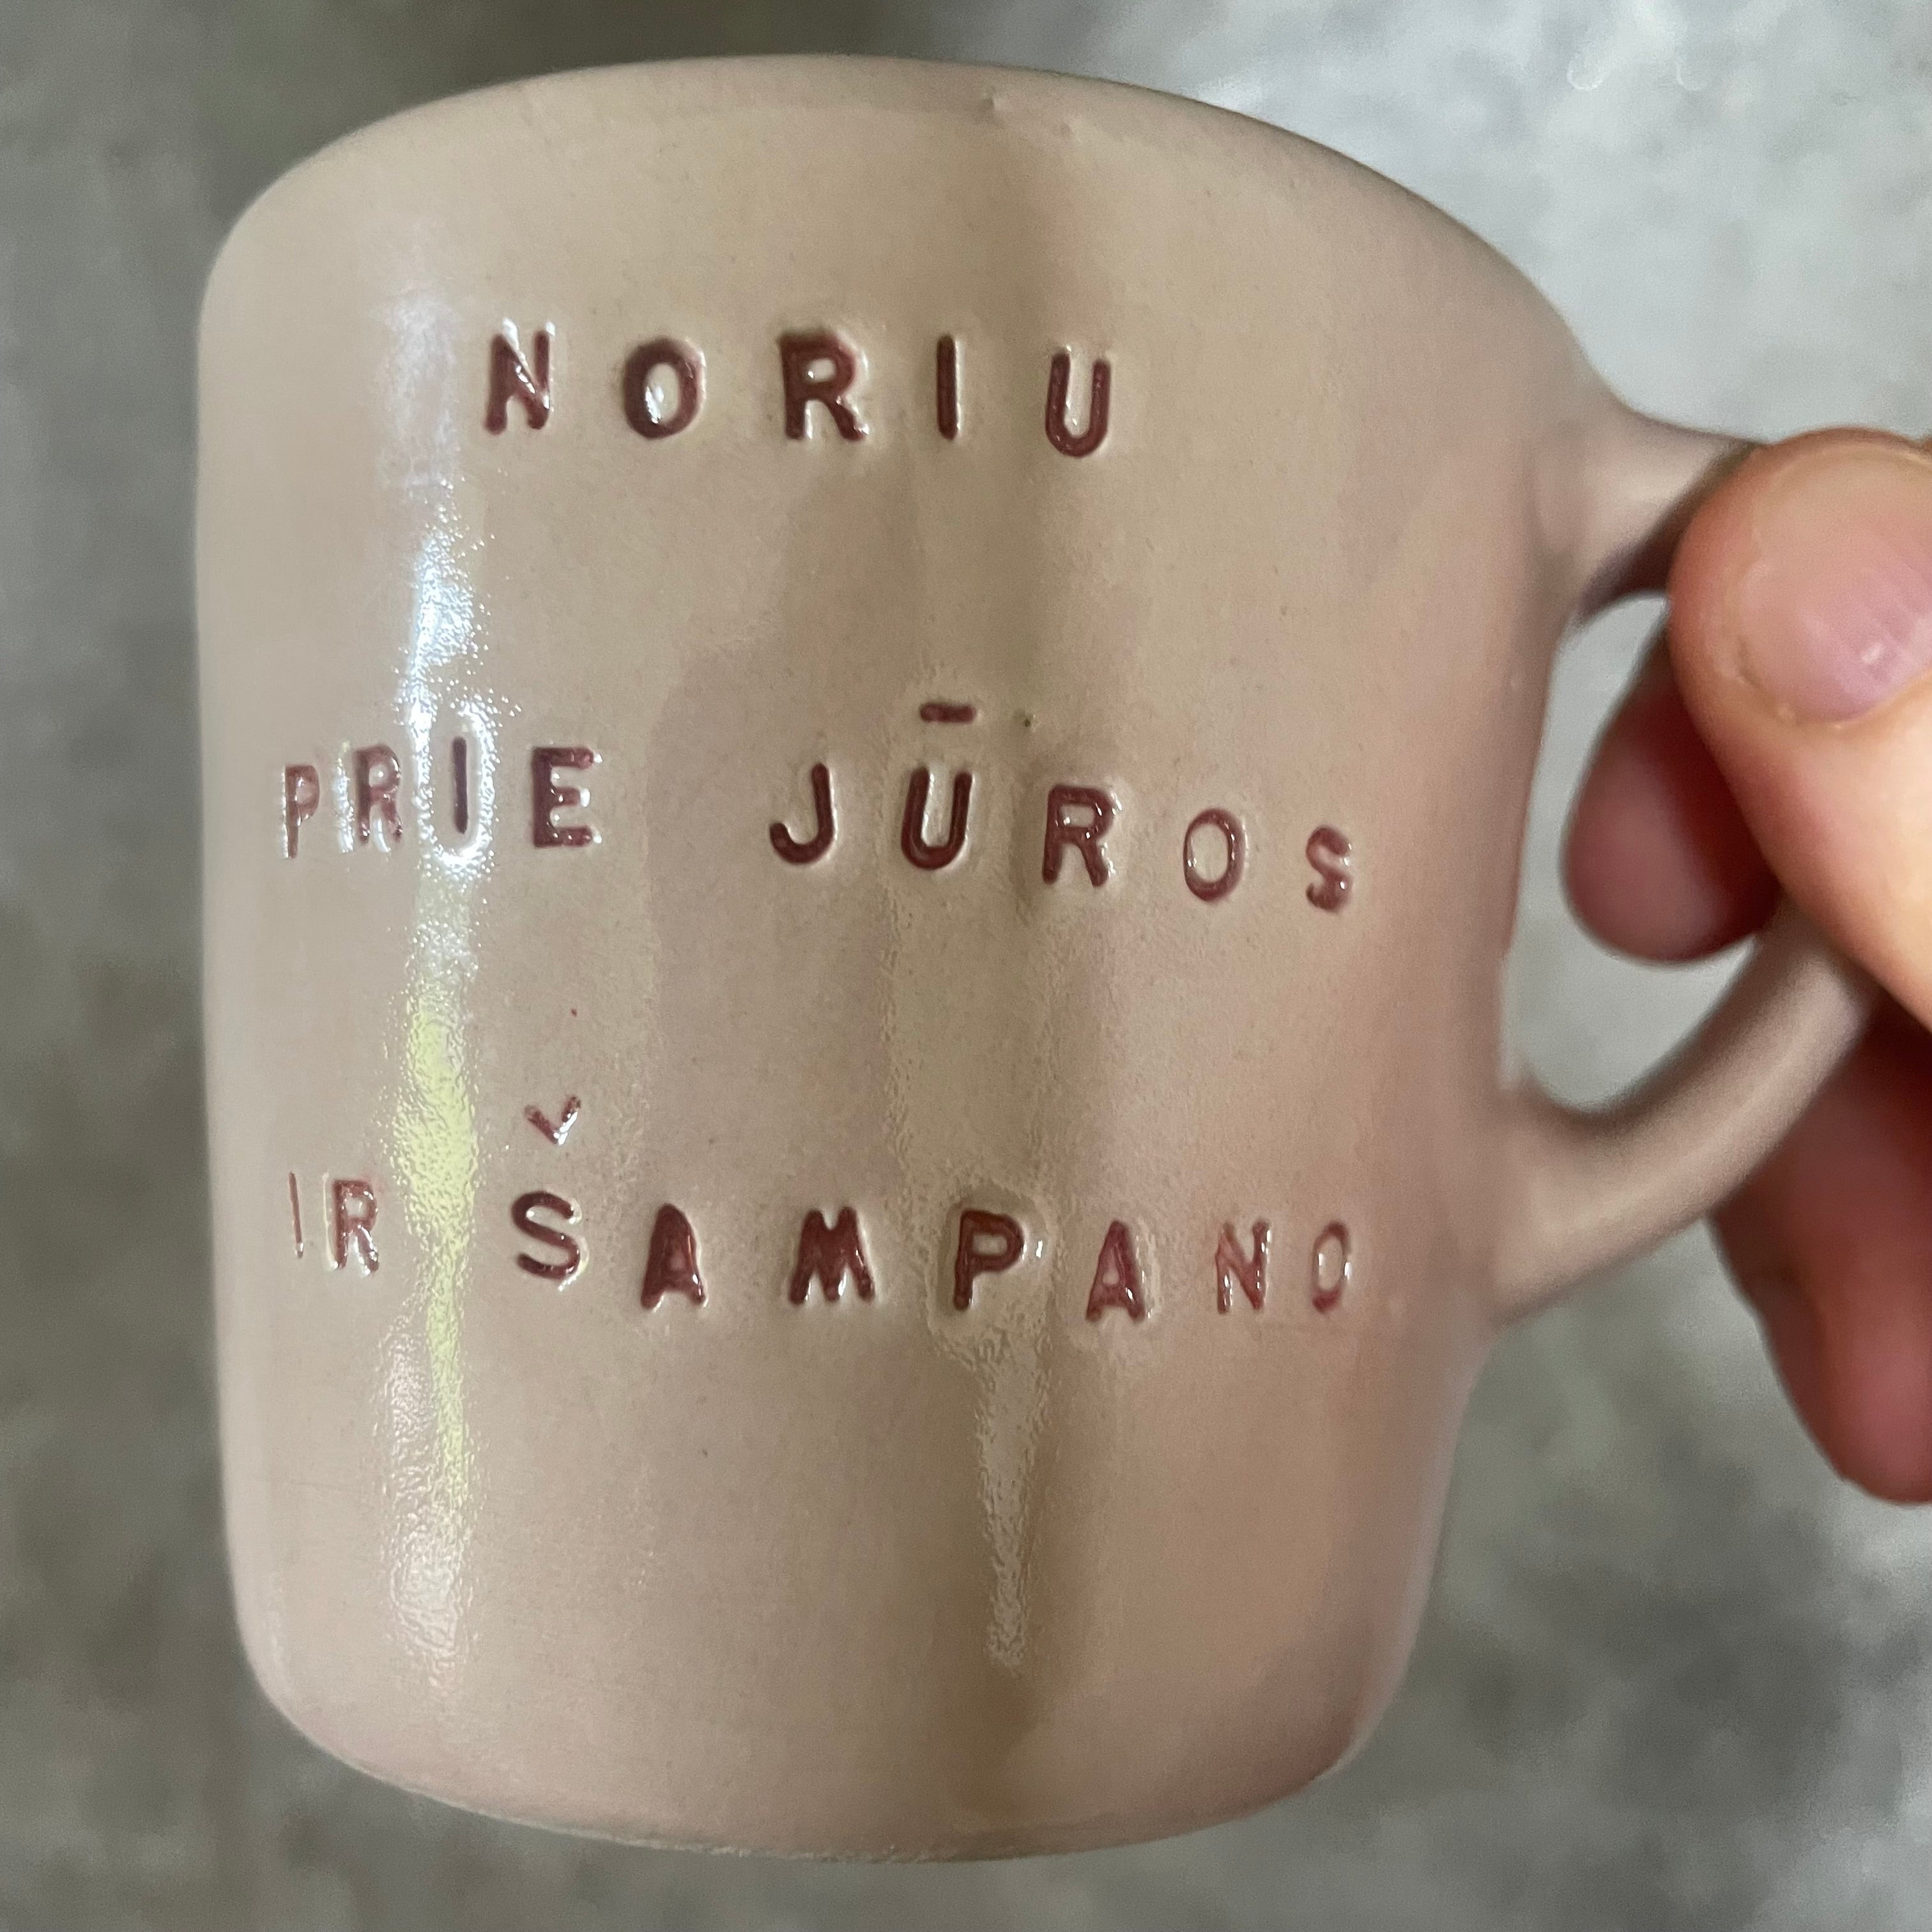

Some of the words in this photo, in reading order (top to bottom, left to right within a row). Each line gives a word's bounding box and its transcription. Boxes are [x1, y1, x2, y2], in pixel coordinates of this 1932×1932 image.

[484, 328, 1112, 458] NORIU
[283, 737, 598, 858] PRIE
[769, 702, 1352, 912] JŪROS
[288, 1171, 379, 1275] IR
[512, 1095, 1351, 1322] ŠAMPANO
